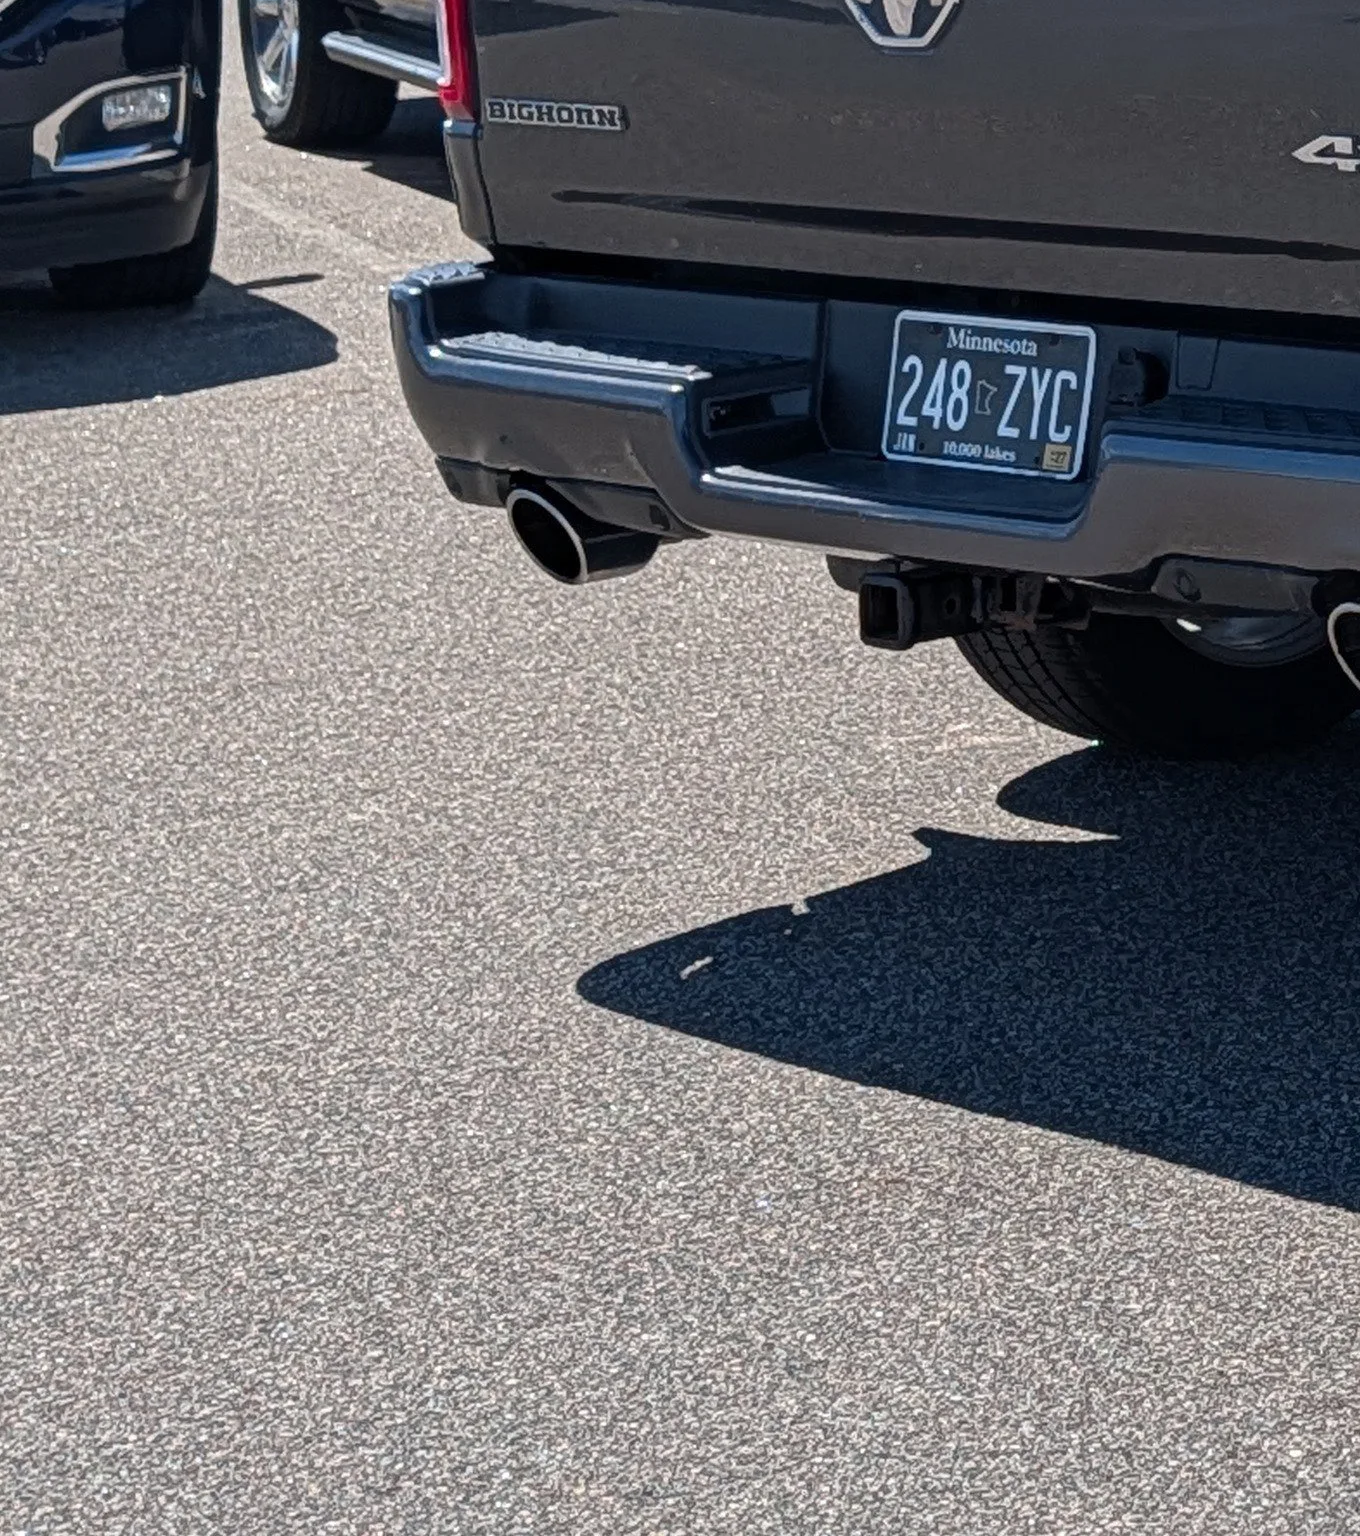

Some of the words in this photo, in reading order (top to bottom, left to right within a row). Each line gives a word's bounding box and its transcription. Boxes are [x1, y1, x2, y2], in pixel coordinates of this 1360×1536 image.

[485, 98, 622, 131] BIGHORN
[946, 326, 1038, 357] Minnesota
[896, 354, 972, 431] 248
[997, 364, 1078, 443] ZYC
